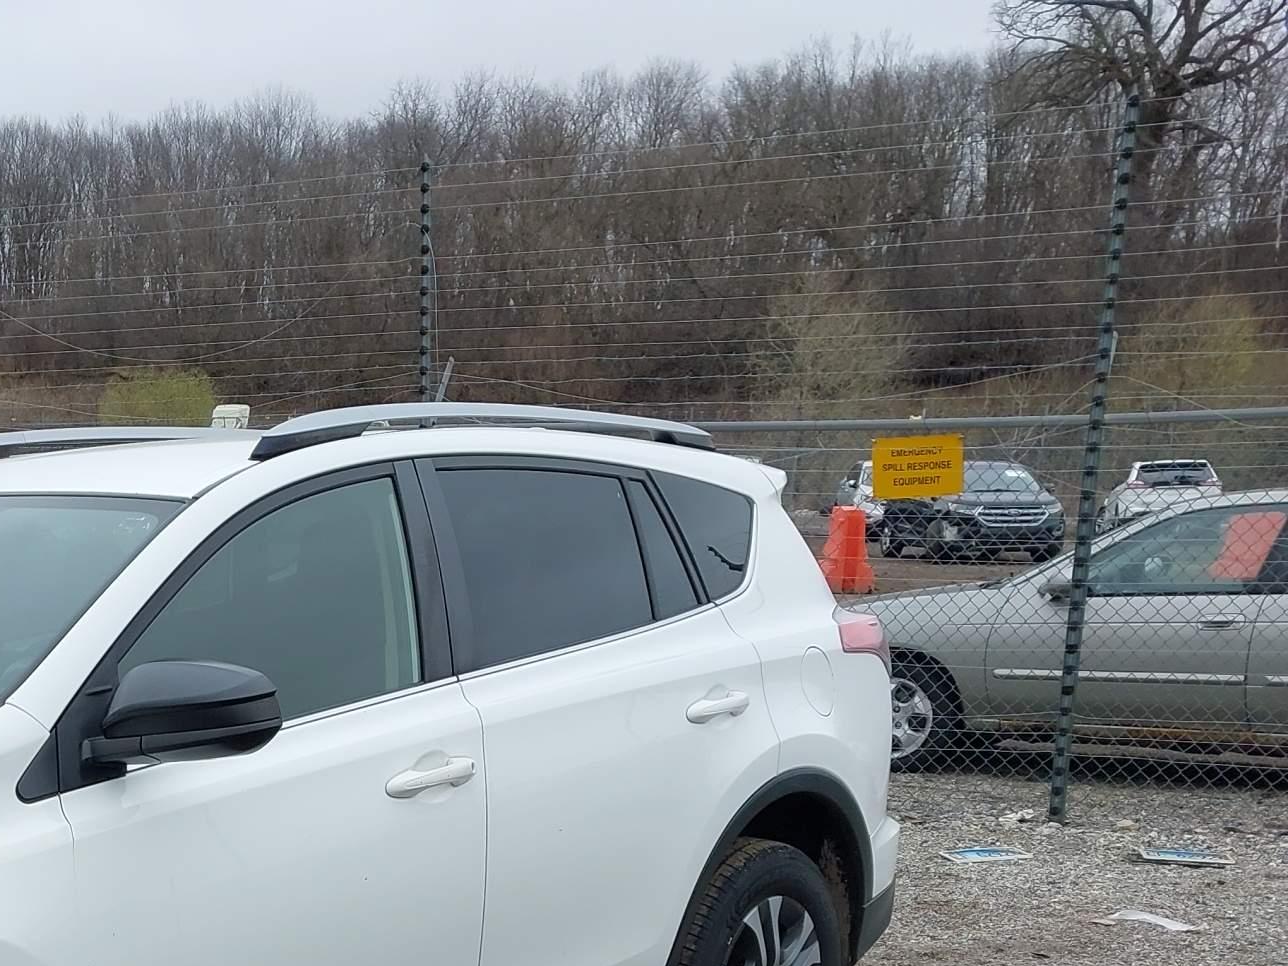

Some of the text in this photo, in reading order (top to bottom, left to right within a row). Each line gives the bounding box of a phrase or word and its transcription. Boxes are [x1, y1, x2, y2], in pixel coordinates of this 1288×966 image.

[891, 447, 943, 457] EMERGENCY
[882, 460, 952, 472] SPILL RESPONSE
[893, 475, 941, 486] EQUIPMENT
